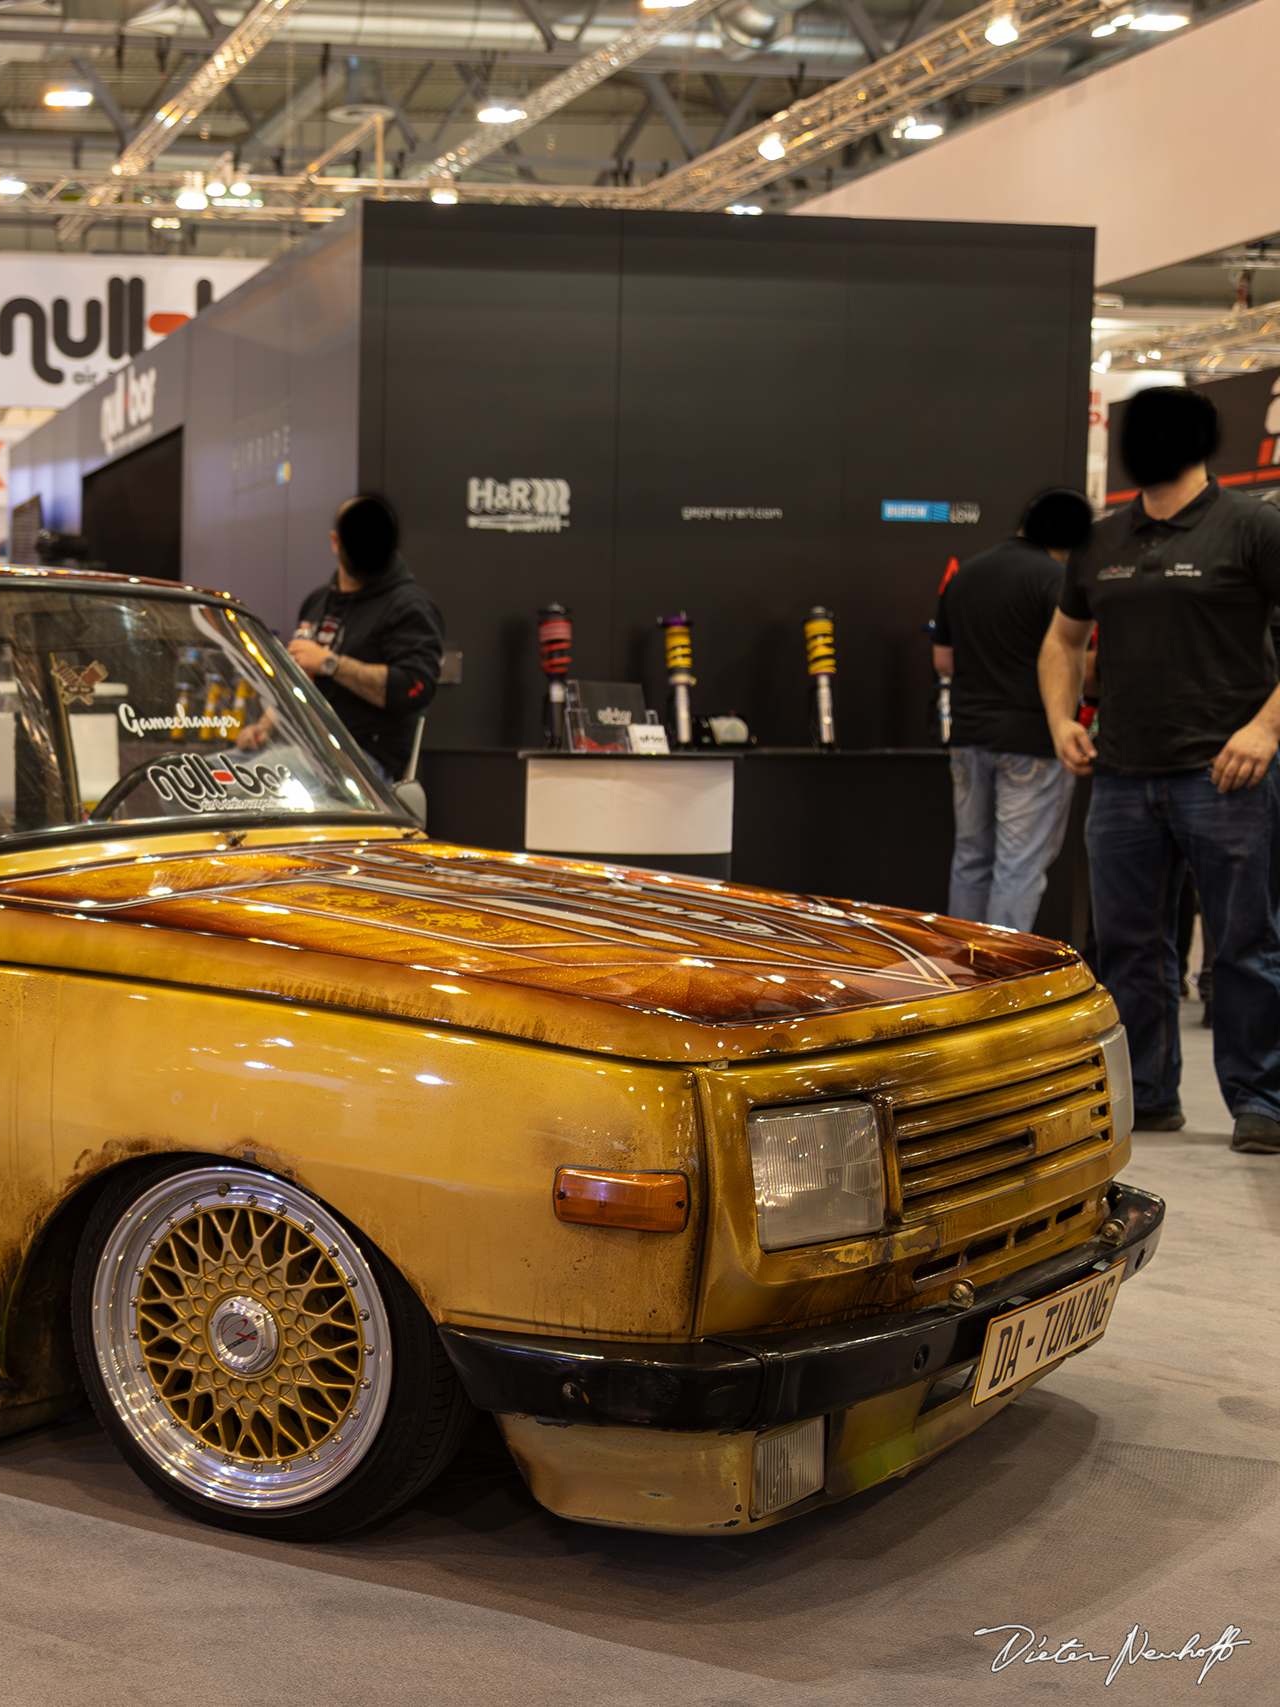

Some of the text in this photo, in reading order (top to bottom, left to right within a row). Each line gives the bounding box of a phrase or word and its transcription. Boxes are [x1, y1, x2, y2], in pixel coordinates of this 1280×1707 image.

[467, 477, 545, 513] H&R
[118, 702, 241, 738] Gamechanger
[1035, 1274, 1116, 1363] TUNING
